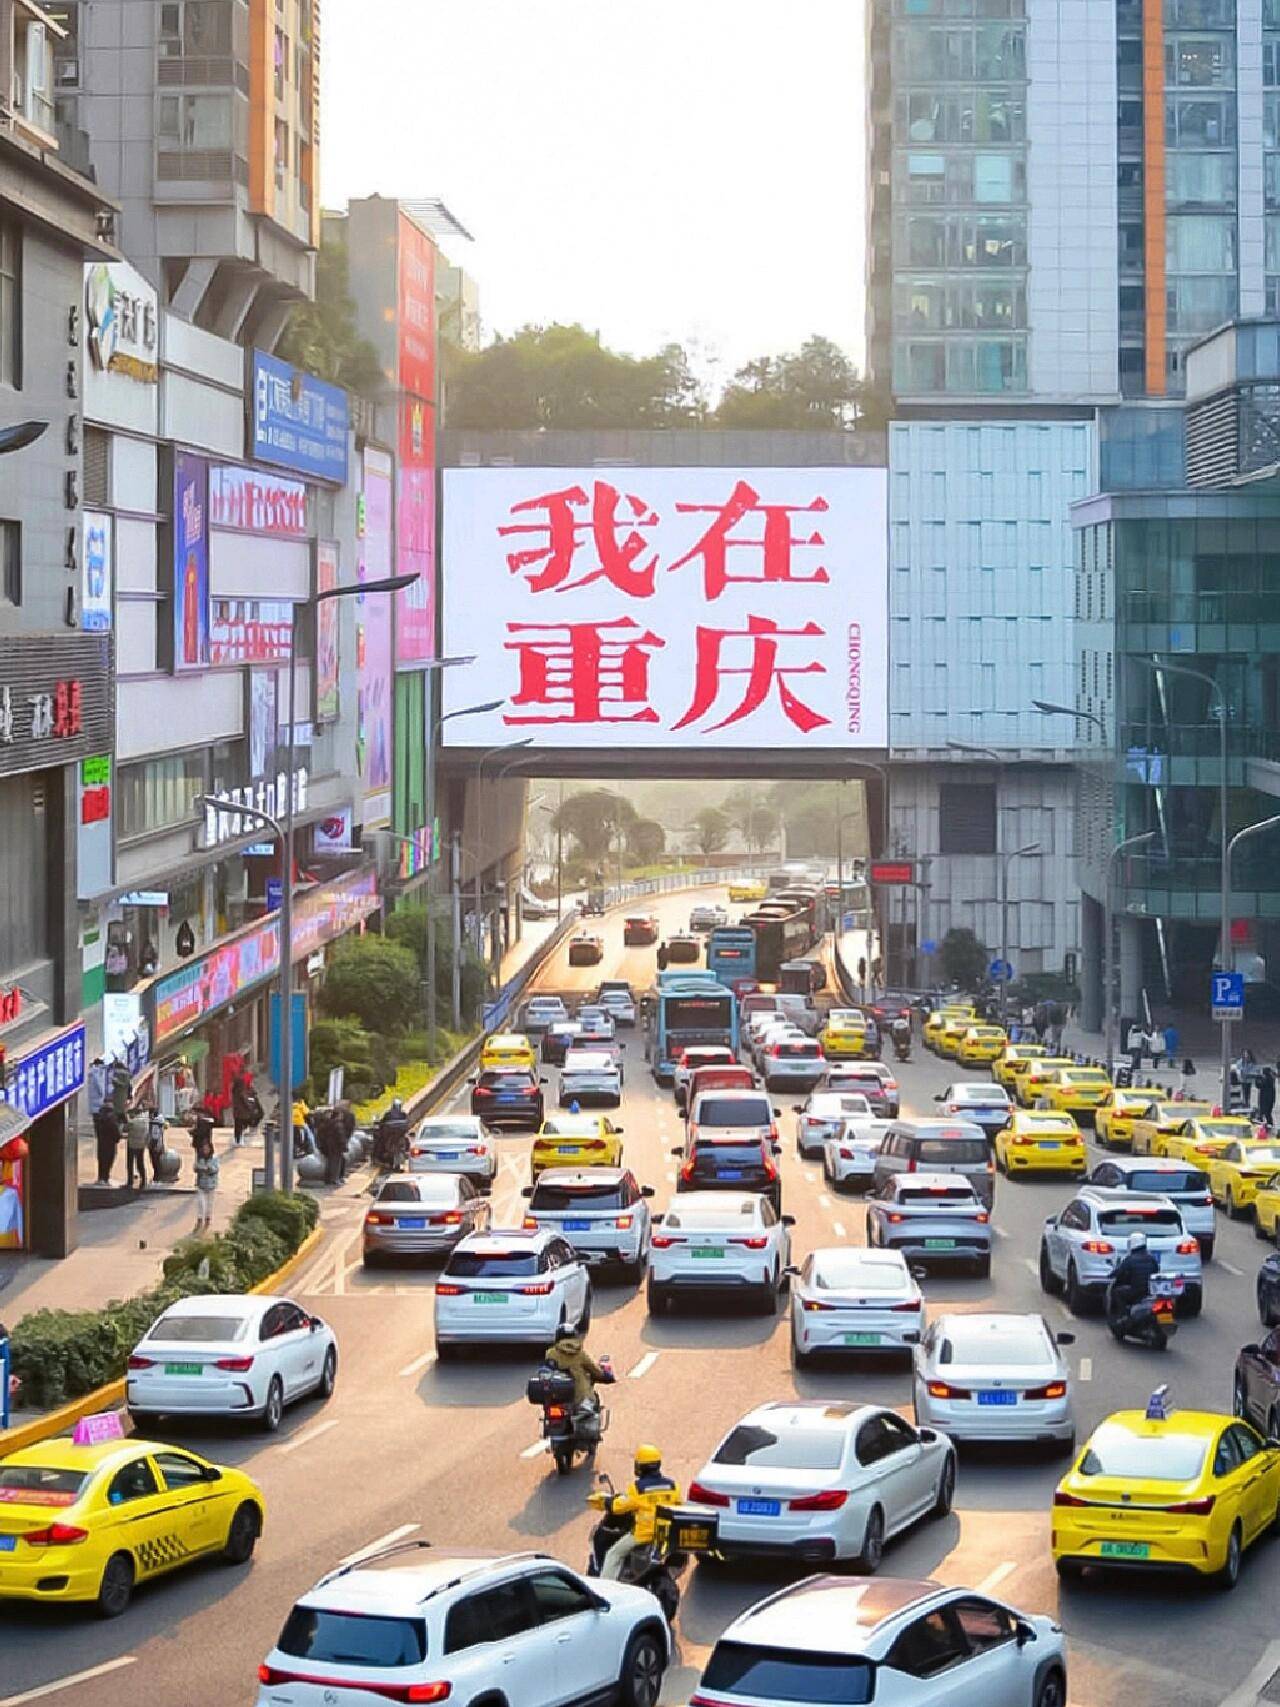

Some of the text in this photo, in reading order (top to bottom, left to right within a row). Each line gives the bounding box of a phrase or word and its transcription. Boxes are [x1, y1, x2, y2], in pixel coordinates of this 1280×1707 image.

[498, 480, 830, 600] 我在
[503, 614, 831, 734] 重庆
[848, 622, 861, 733] CHONGQING
[1216, 978, 1231, 1002] P
